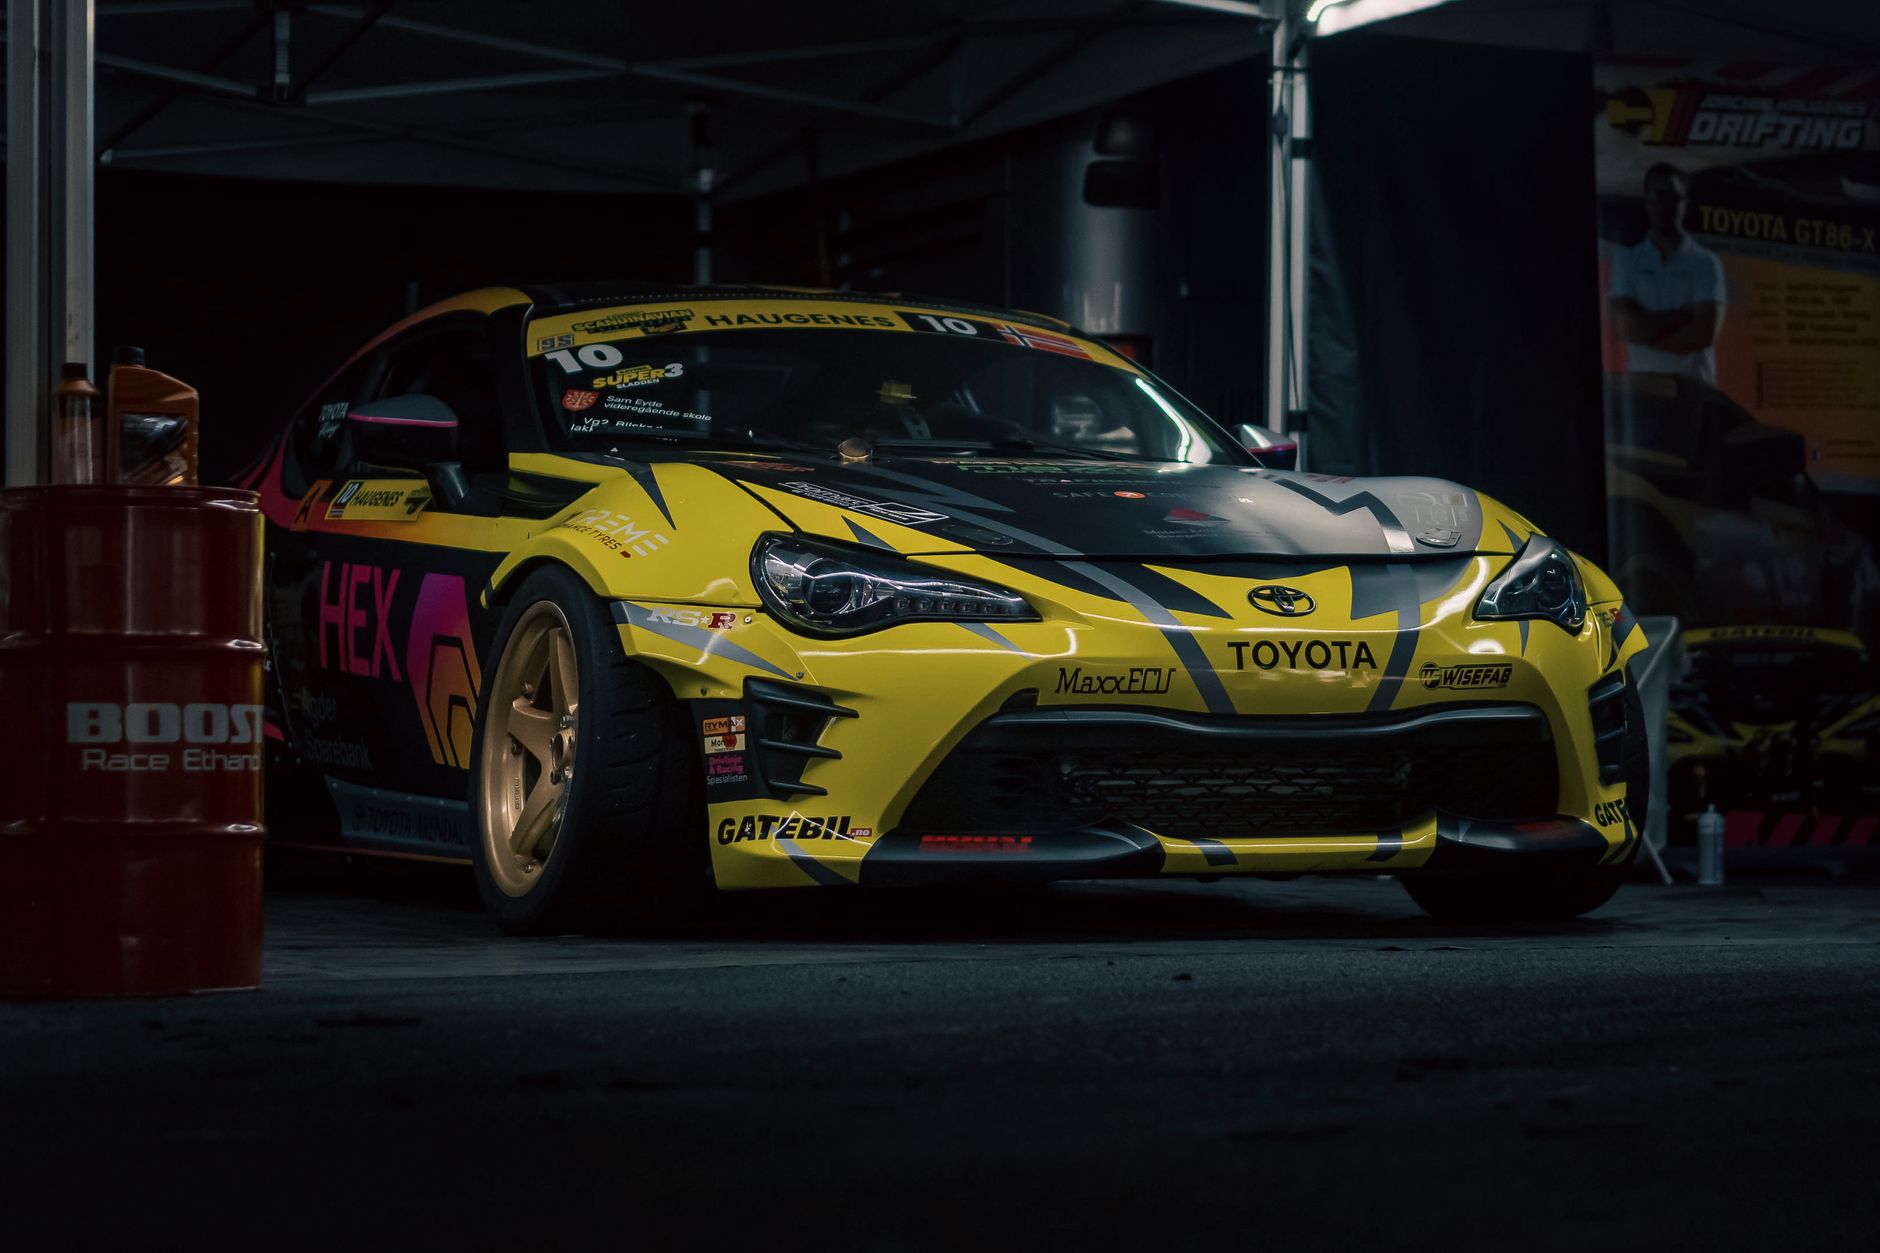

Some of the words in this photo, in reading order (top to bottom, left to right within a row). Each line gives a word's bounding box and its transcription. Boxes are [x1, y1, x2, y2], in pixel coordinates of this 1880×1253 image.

[1688, 111, 1864, 149] DRIFTING
[1700, 204, 1787, 242] TOYOTA
[572, 309, 694, 331] SCANDINAVIAN
[704, 313, 896, 328] HAUGENES
[916, 314, 979, 336] 10
[544, 343, 623, 374] 10
[606, 395, 632, 404] Sam
[635, 397, 663, 408] Eyde
[682, 411, 712, 421] skole
[349, 491, 404, 506] HAUGENES
[592, 530, 622, 550] TYRES
[319, 561, 403, 683] HEX
[1227, 639, 1378, 671] TOYOTA
[1054, 667, 1176, 695] MaxxECU
[1443, 667, 1513, 686] WISEFAB
[704, 718, 743, 731] RYMAX
[81, 748, 170, 773] Race
[706, 774, 748, 786] Spesialisten
